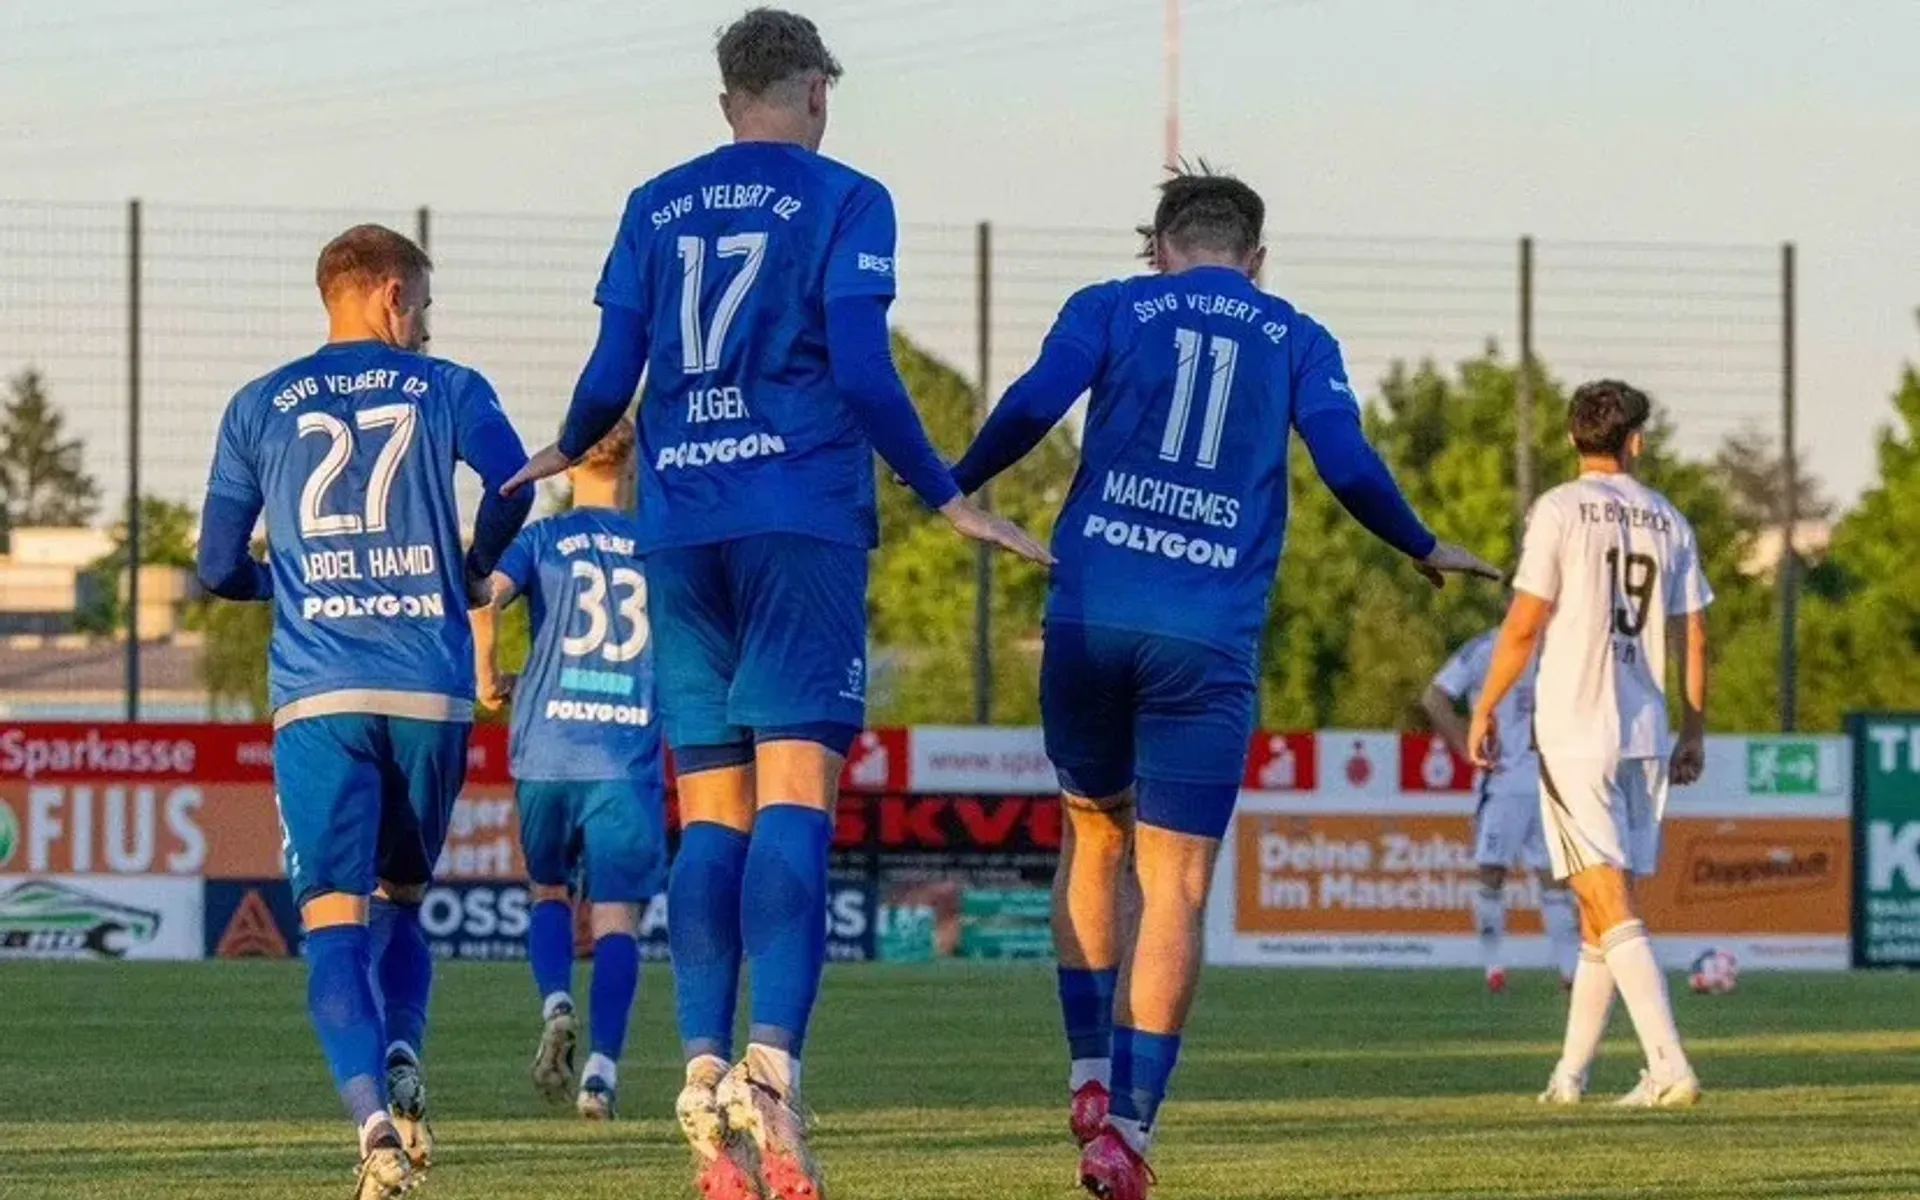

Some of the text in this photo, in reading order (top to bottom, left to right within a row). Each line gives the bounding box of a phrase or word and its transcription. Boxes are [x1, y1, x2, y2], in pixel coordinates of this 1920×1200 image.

[651, 184, 802, 231] SSVG VELBERT 02
[677, 231, 769, 374] 17
[1134, 292, 1178, 323] SSVG
[1185, 293, 1262, 323] VELBERT
[273, 368, 429, 414] SSVG VELBERT 02
[1159, 327, 1239, 470] 11
[296, 403, 417, 539] 27
[655, 432, 786, 472] POLYGON
[1102, 469, 1240, 530] MACHTEMES
[368, 544, 435, 578] HAMID
[1083, 514, 1238, 569] POLYGON
[303, 592, 444, 620] POLYGON
[562, 559, 649, 662] 33
[1605, 546, 1656, 637] 19
[544, 699, 649, 727] POLYGON
[0, 729, 195, 779] Sparkasse
[28, 784, 206, 875] FIUS
